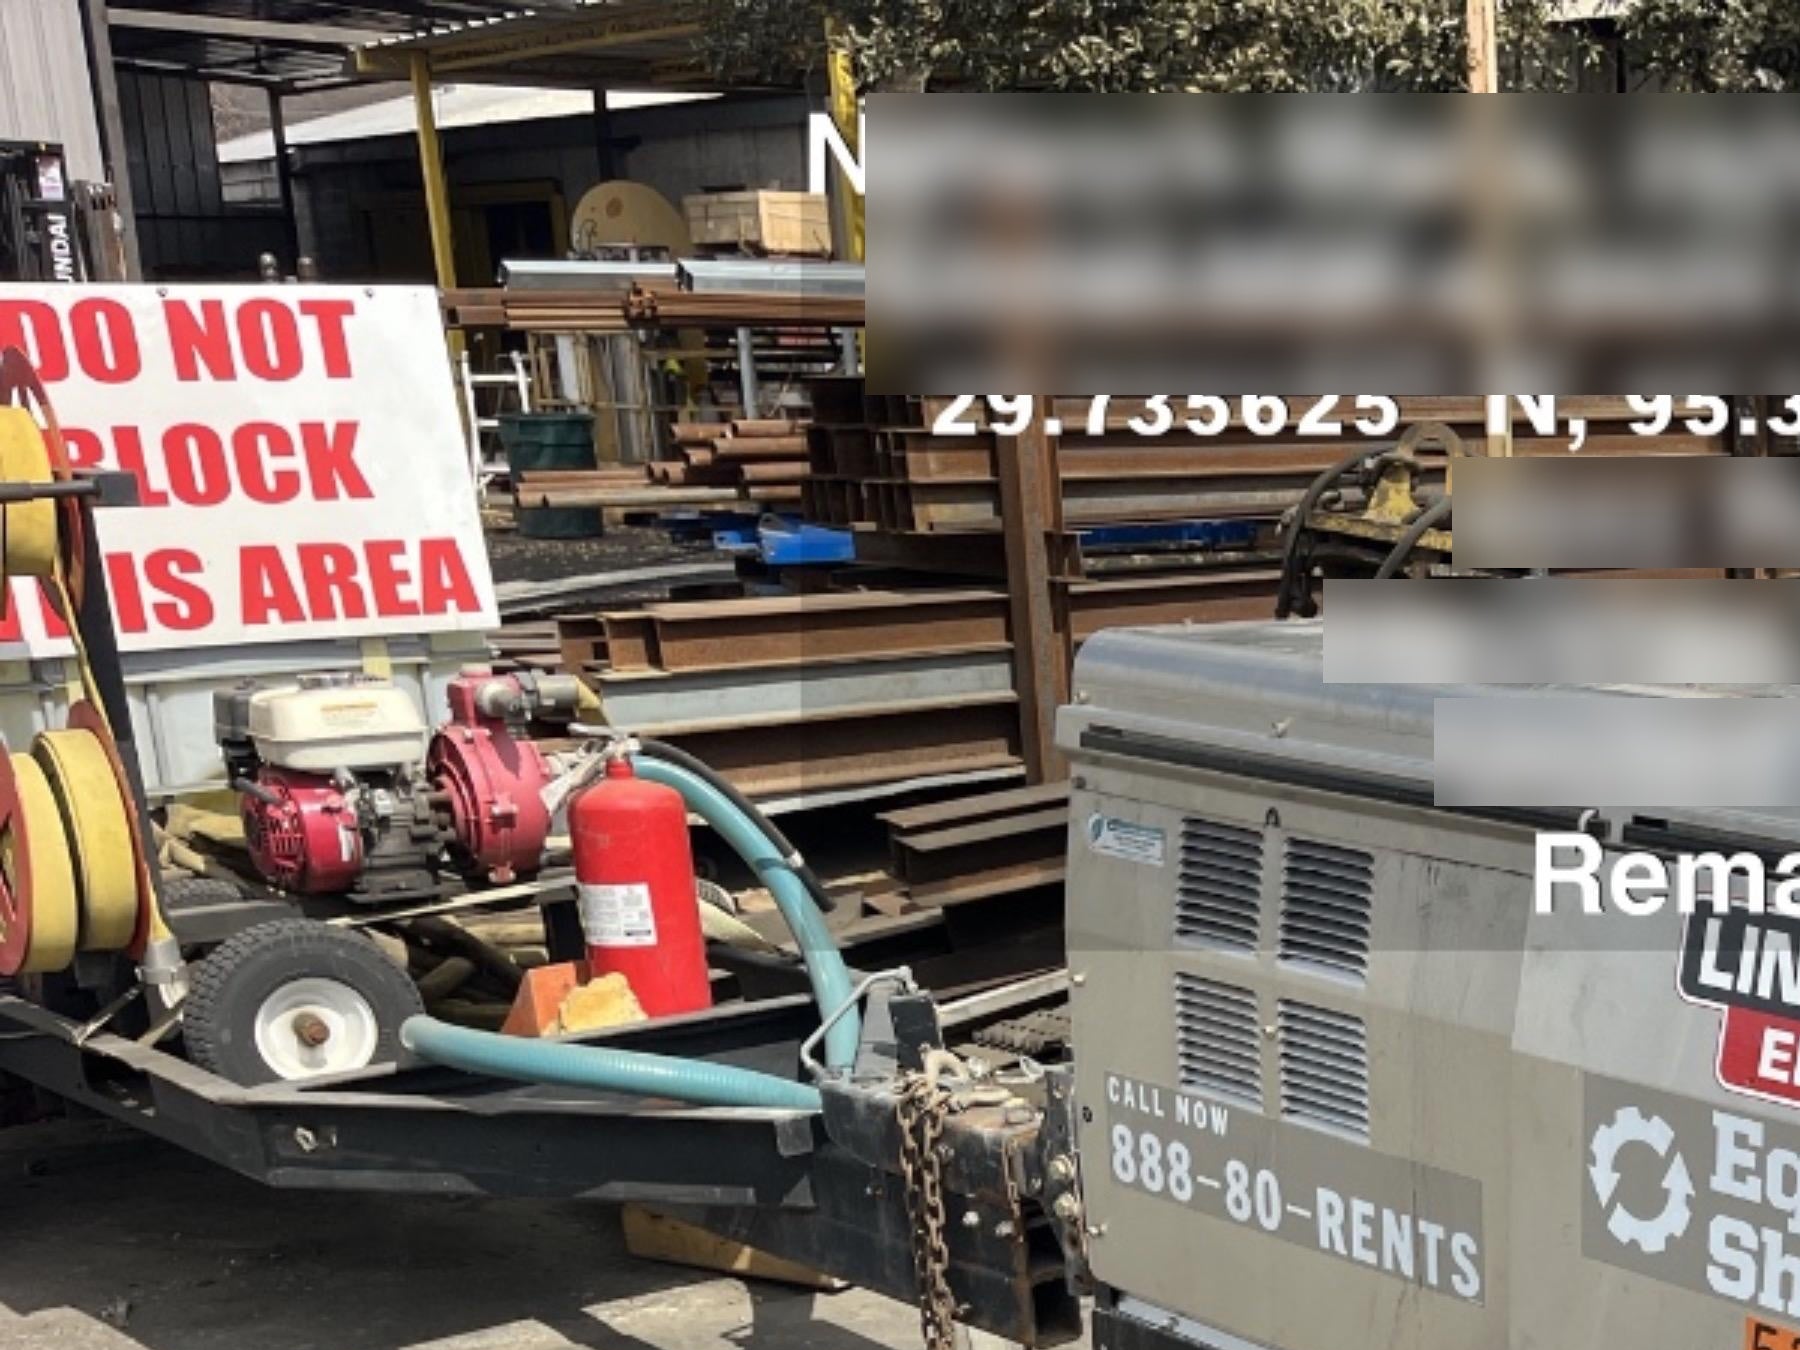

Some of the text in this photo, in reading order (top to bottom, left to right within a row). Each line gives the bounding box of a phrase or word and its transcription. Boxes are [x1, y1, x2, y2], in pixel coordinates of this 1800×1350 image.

[0, 297, 356, 384] DO NOT
[239, 537, 482, 627] AREA
[1107, 1075, 1230, 1136] CALL NOW
[1111, 1123, 1482, 1300] 888-80-RENTS
